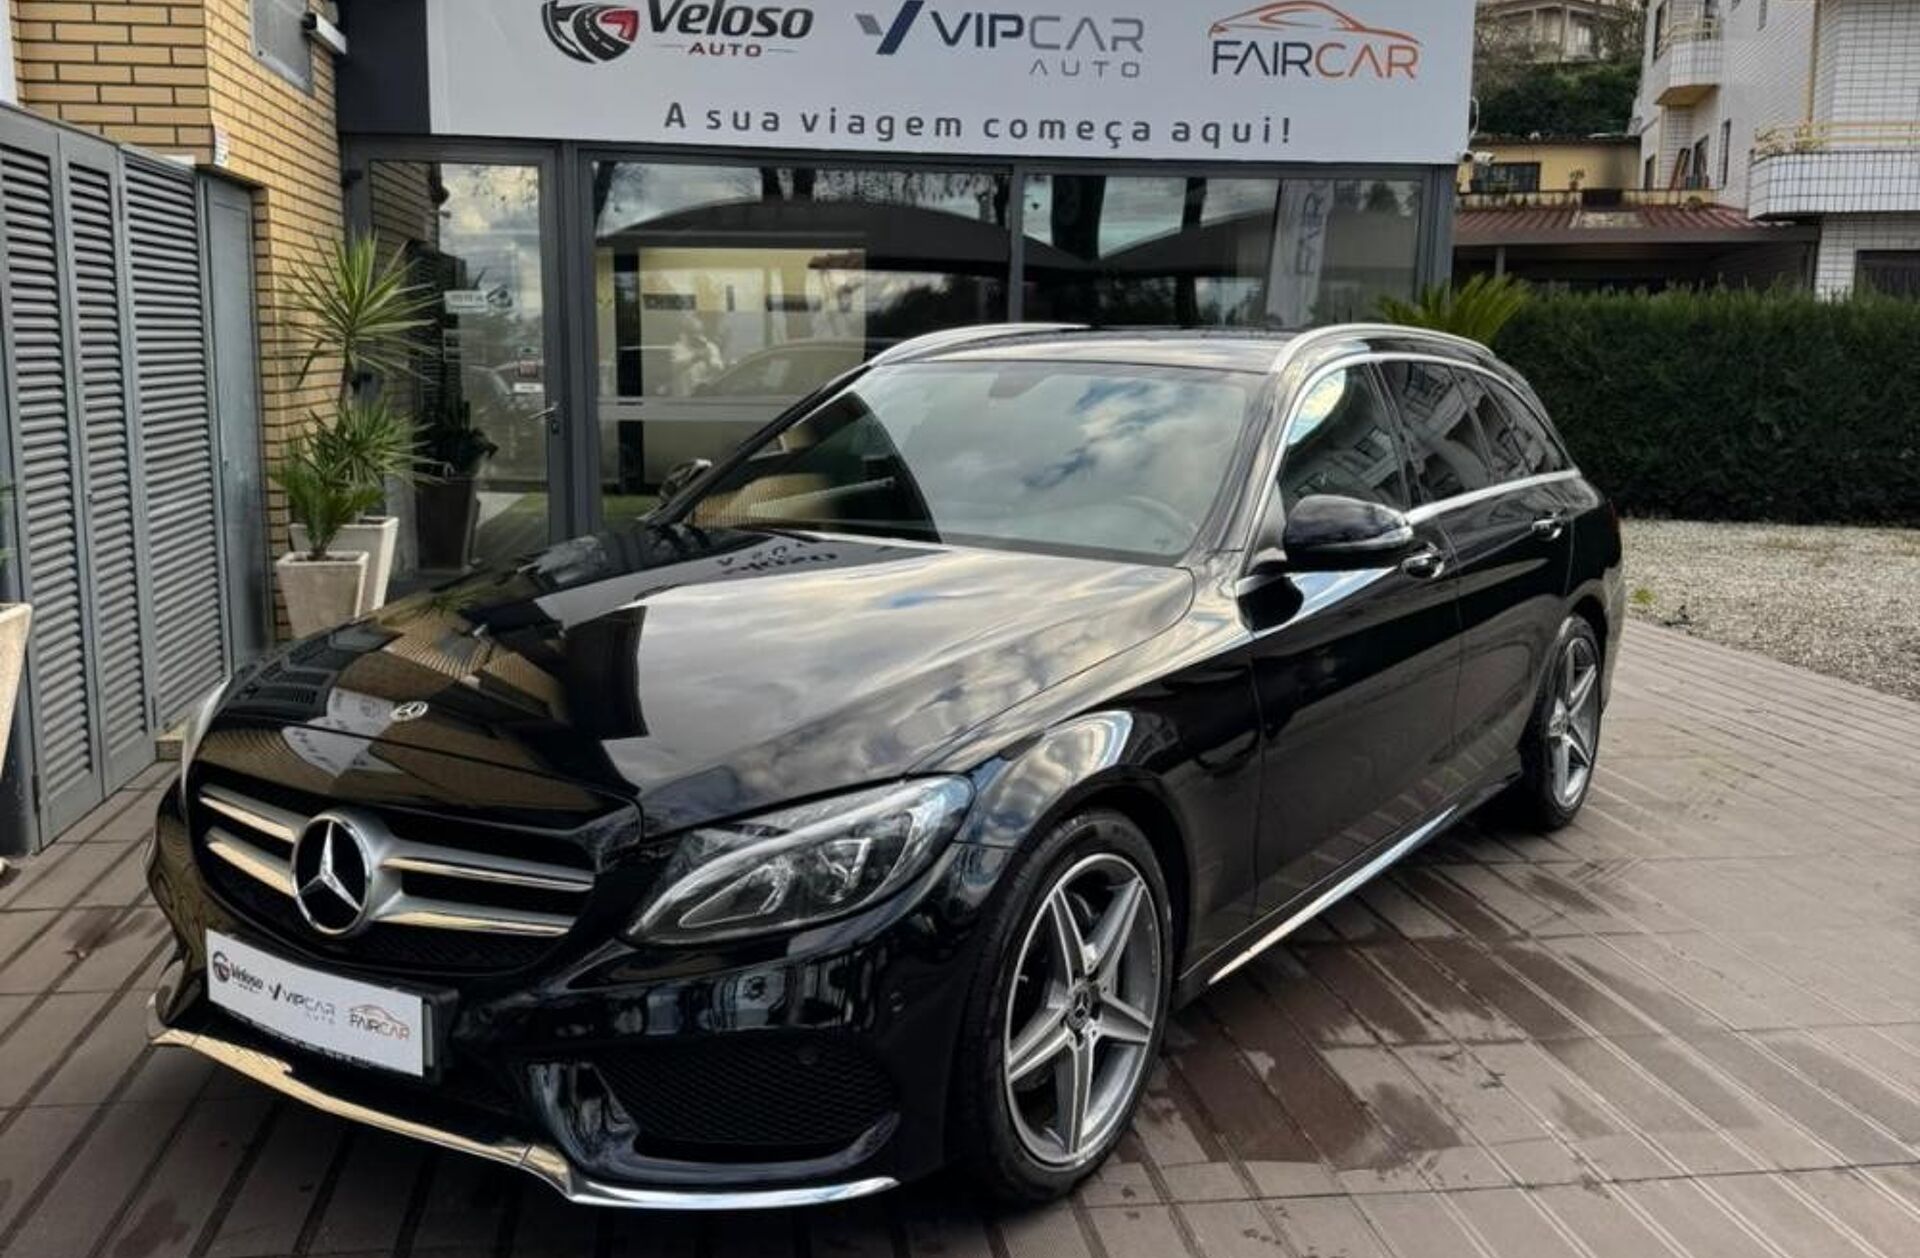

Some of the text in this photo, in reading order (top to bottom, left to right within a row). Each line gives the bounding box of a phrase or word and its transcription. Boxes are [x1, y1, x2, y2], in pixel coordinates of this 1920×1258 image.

[650, 0, 814, 38] Veloso
[930, 12, 1143, 52] VIPCAR
[689, 42, 762, 57] AUTO
[1212, 40, 1419, 79] FAIRCAR
[1029, 60, 1140, 78] AUTO
[664, 102, 1290, 149] A sua viagem começa aqui!
